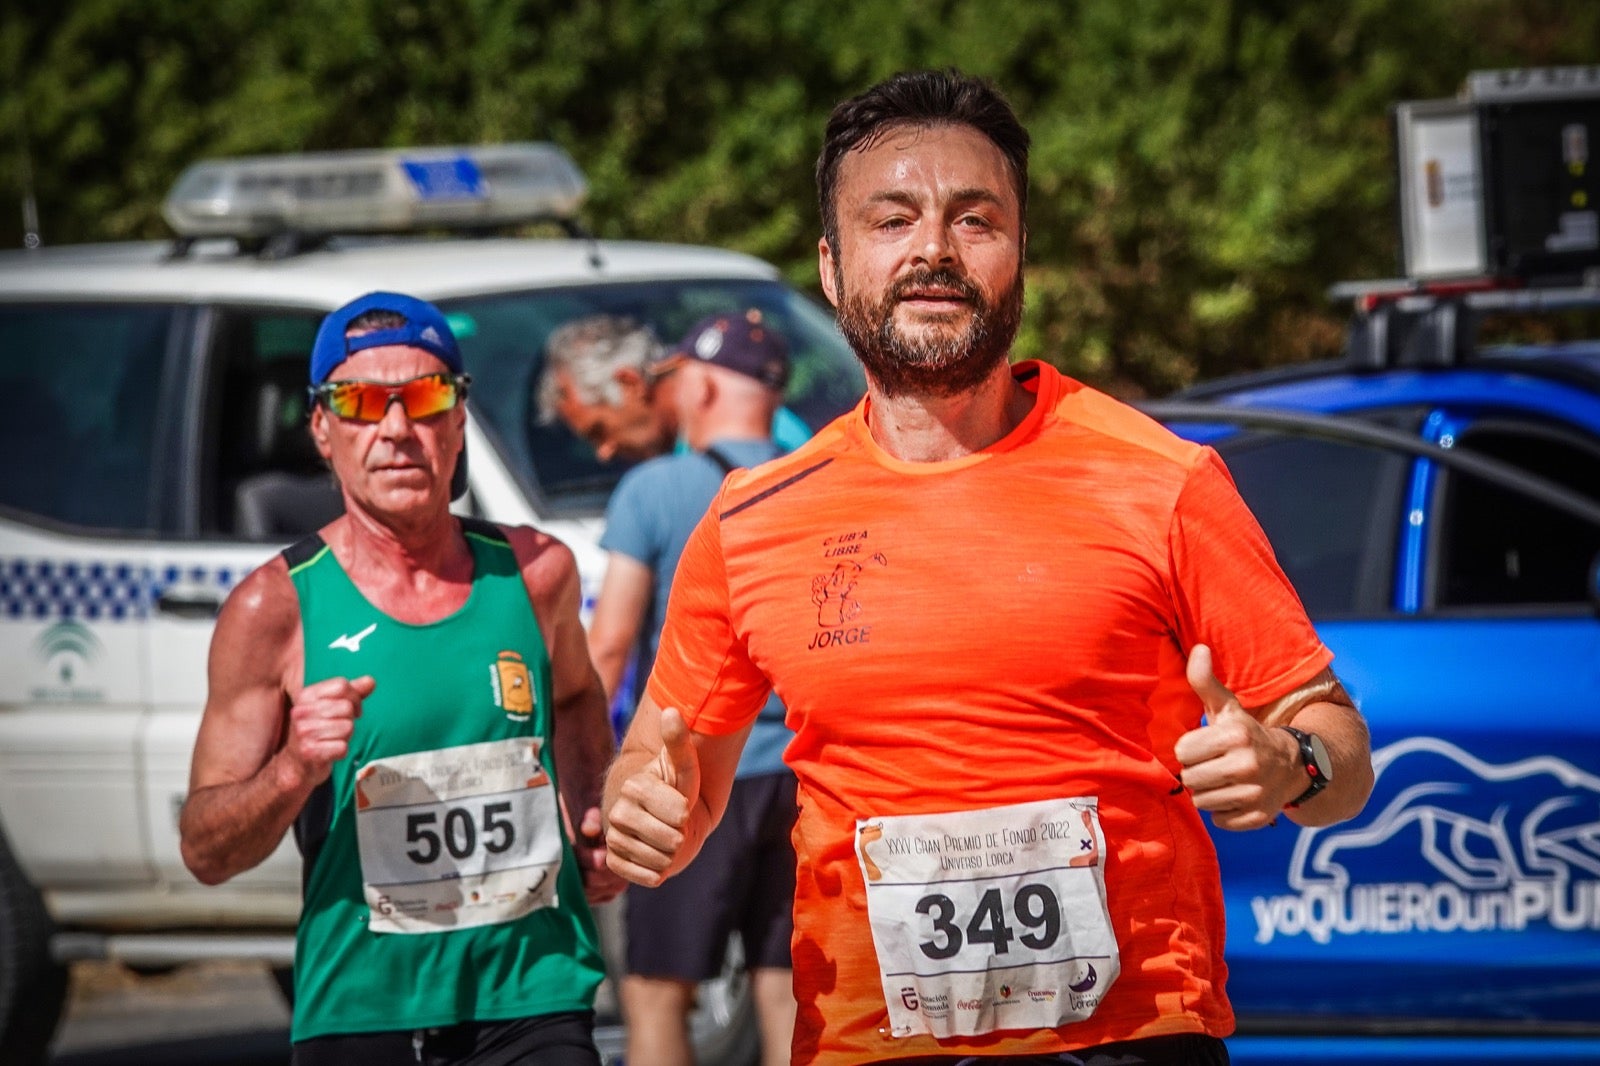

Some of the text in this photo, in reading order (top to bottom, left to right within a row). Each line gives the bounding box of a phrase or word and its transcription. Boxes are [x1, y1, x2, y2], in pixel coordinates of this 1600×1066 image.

[824, 543, 862, 558] LIBRE
[808, 626, 872, 650] JORGE
[406, 802, 515, 864] 505
[1040, 821, 1071, 841] 2022
[940, 852, 1015, 872] UNIVERSO LORCA
[915, 883, 1061, 960] 349
